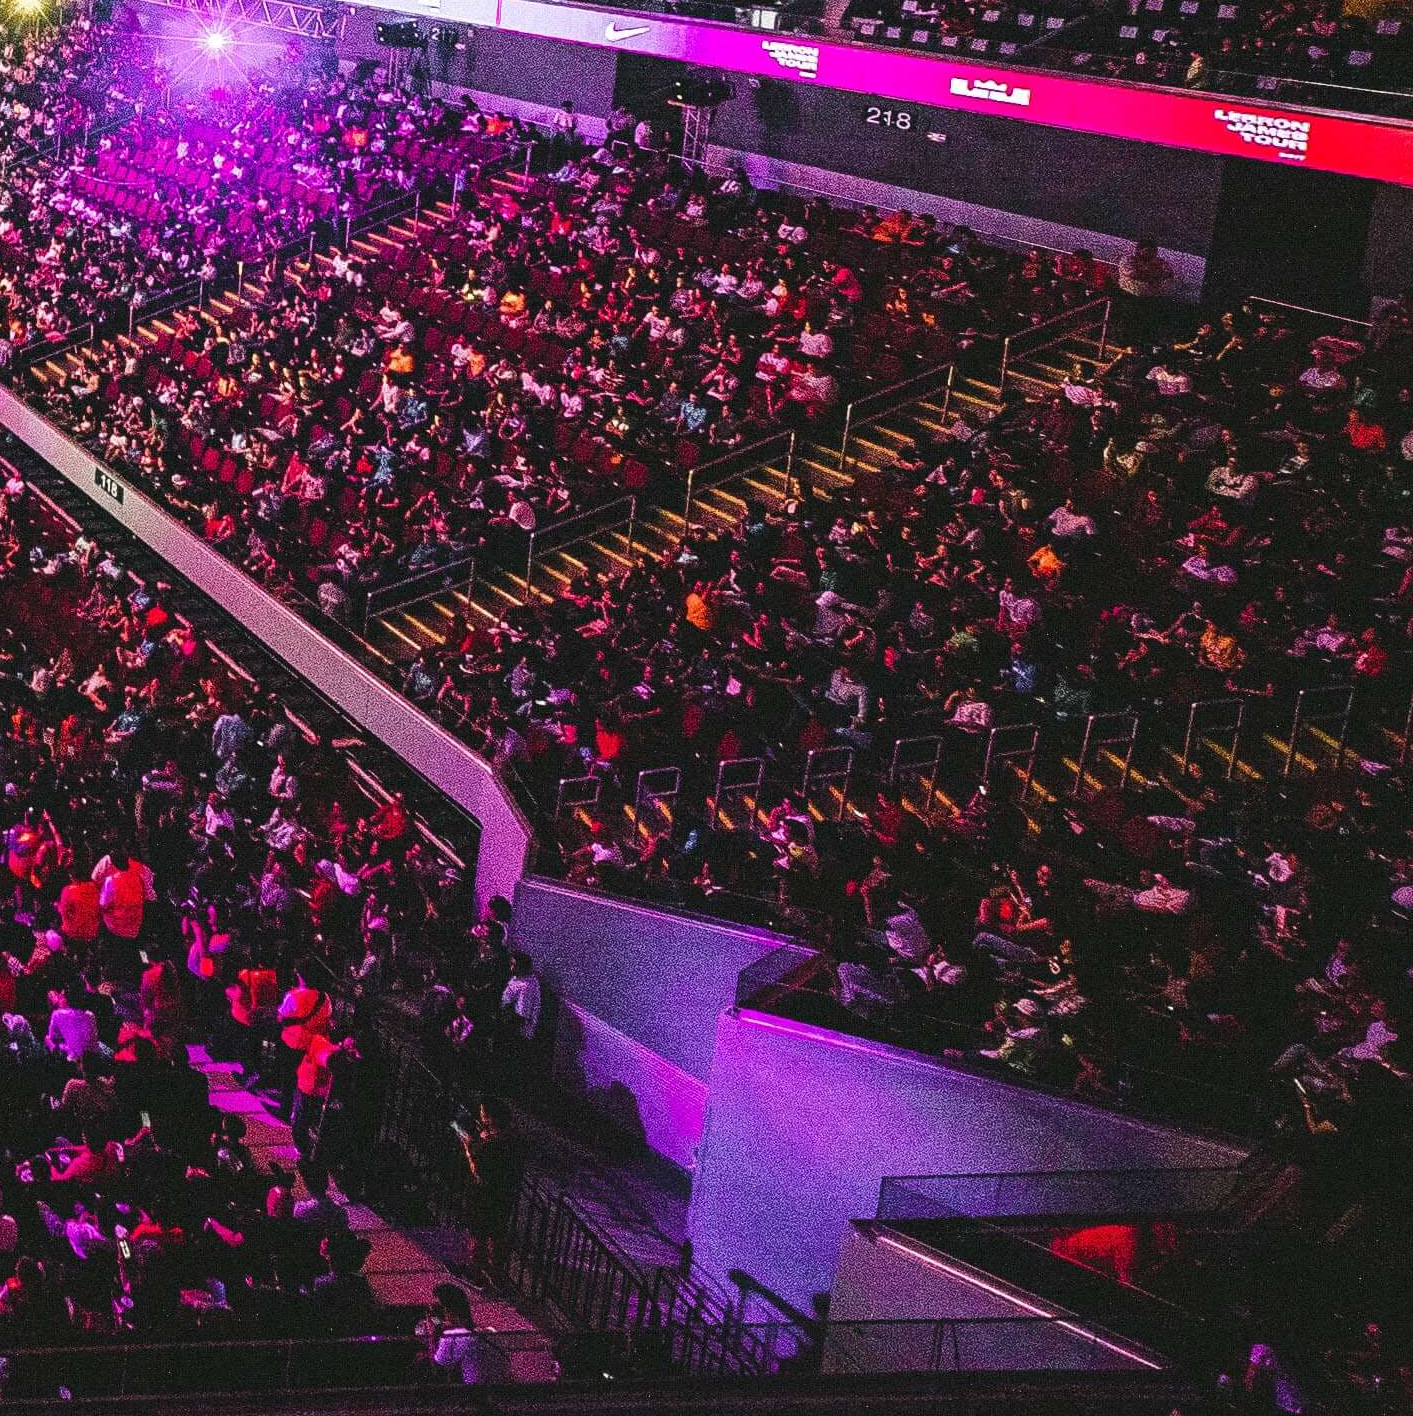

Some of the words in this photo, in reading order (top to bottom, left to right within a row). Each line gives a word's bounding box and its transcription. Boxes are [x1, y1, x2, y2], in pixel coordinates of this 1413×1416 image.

[866, 107, 911, 129] 218
[1214, 109, 1311, 133] LEBRON
[1227, 122, 1309, 142] JAMES
[1239, 131, 1308, 152] TOUR
[100, 474, 118, 498] 118
